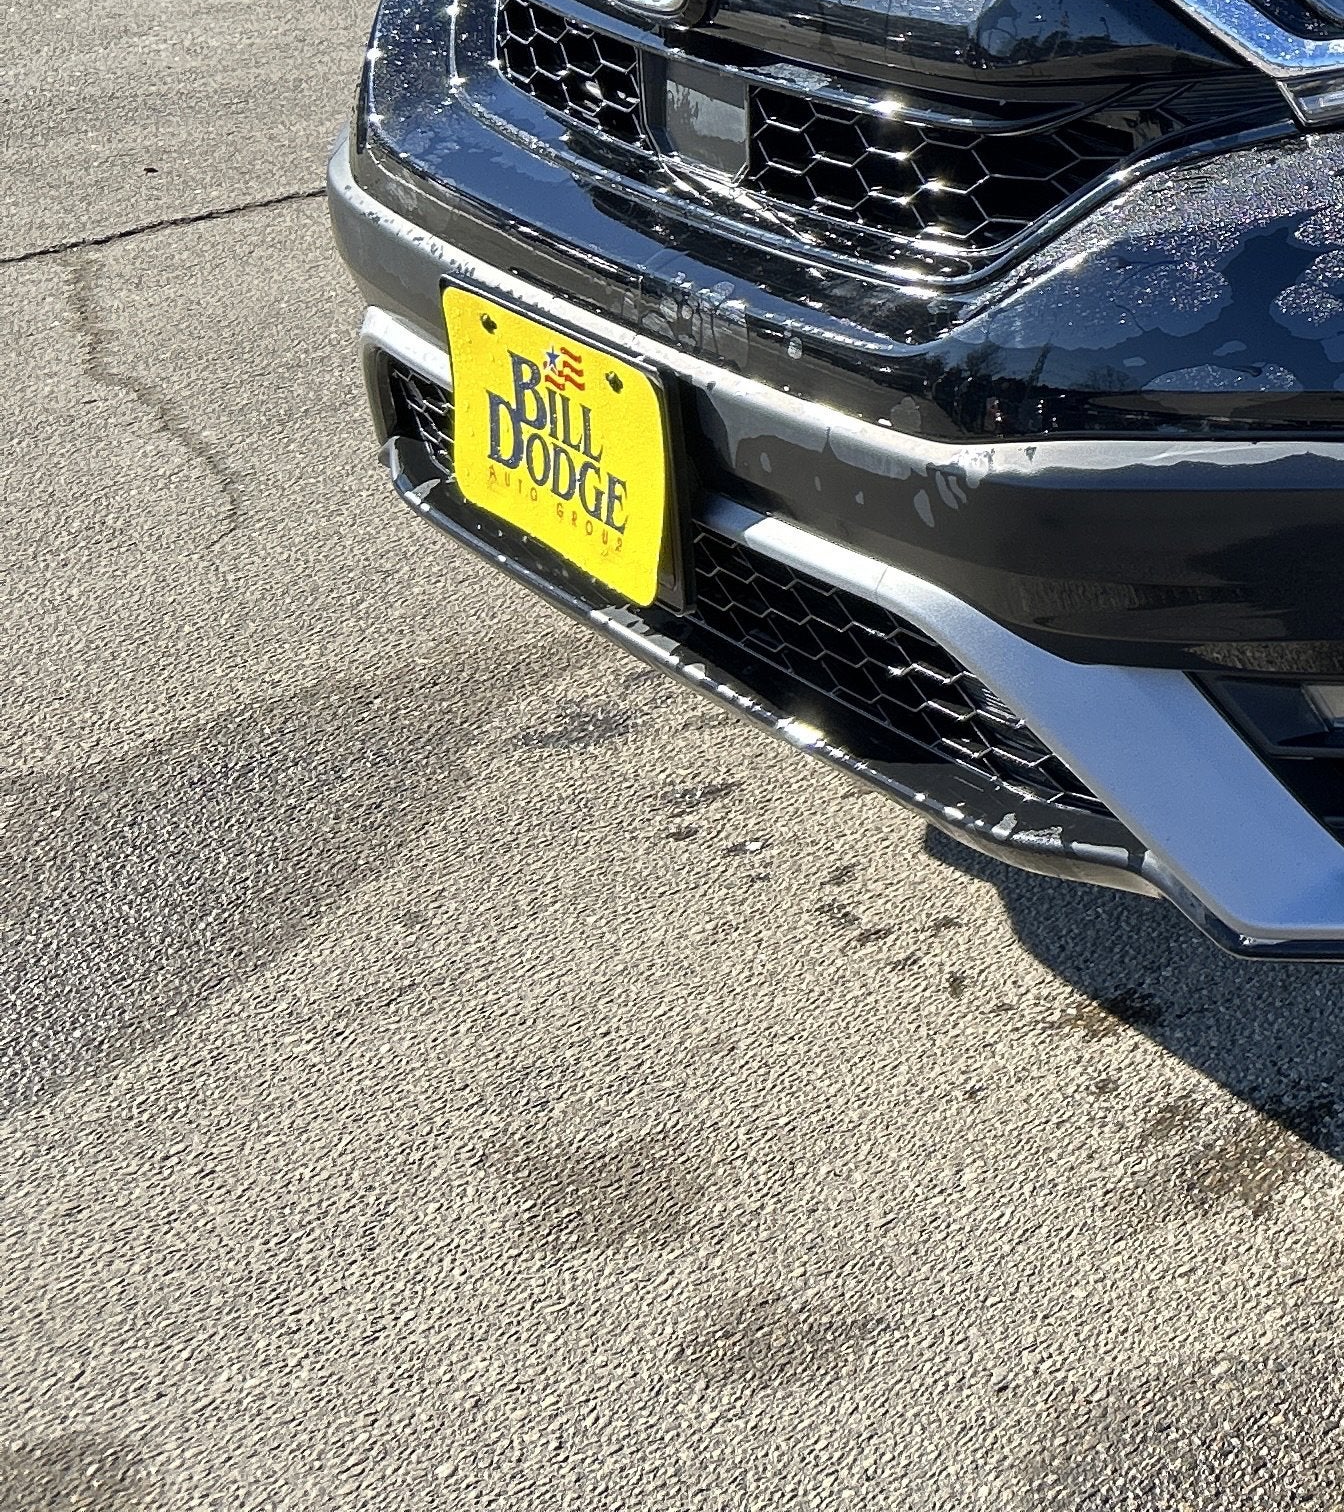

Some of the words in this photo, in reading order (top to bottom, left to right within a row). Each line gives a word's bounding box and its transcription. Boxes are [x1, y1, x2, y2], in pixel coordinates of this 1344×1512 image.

[486, 389, 628, 534] DODGE
[507, 349, 603, 462] BILL
[488, 465, 538, 502] AUTO
